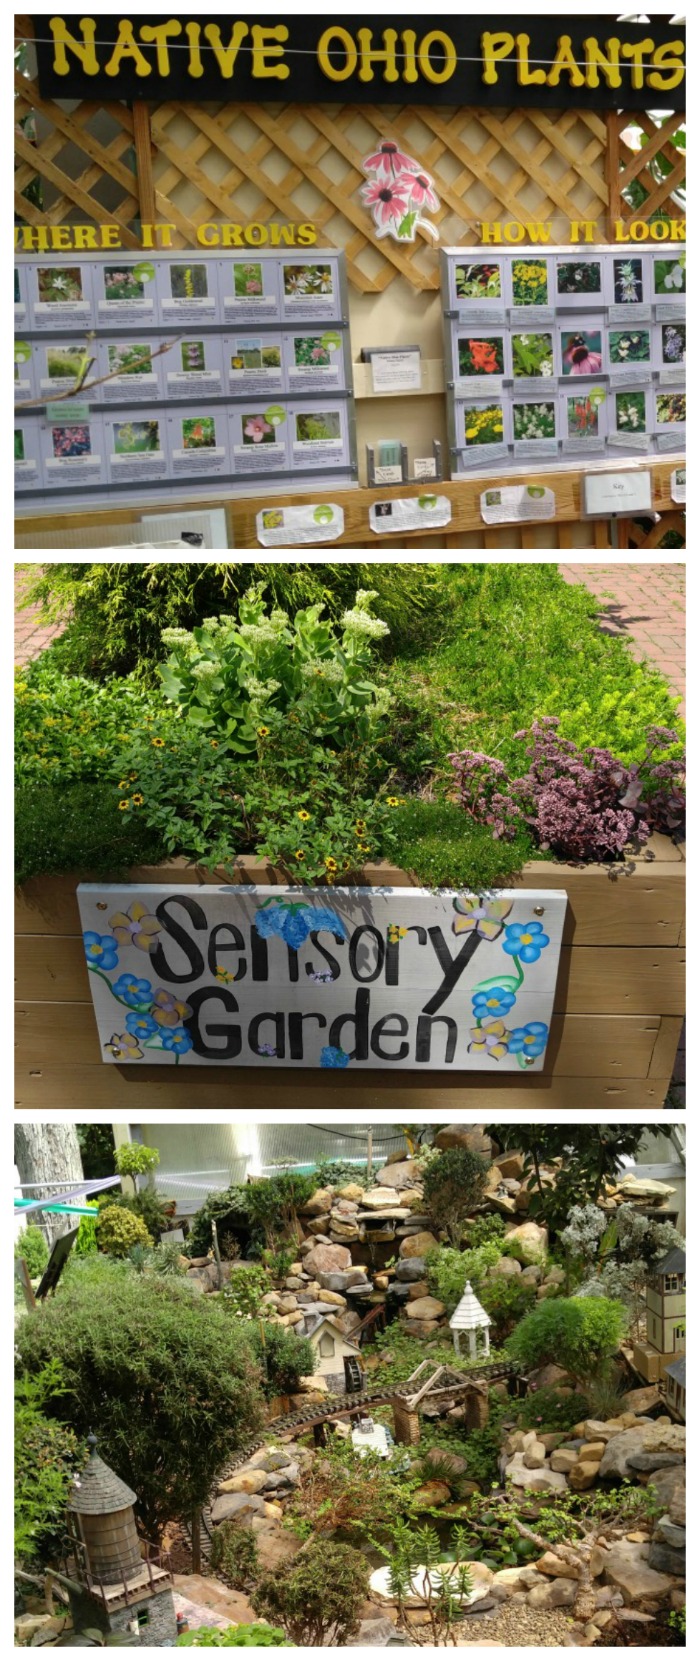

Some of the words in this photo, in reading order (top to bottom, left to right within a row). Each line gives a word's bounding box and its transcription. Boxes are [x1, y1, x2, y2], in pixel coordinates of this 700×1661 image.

[49, 16, 290, 79] NATIVE
[317, 26, 457, 85] OHIO
[480, 31, 685, 90] PLANTS
[14, 224, 122, 249] HERE
[141, 223, 177, 247] IT
[196, 222, 318, 247] GROWS
[480, 219, 553, 244] HOW
[569, 221, 598, 243] IT
[615, 219, 686, 242] LOOK
[149, 895, 482, 1014] Sensory
[182, 986, 458, 1063] Garden
